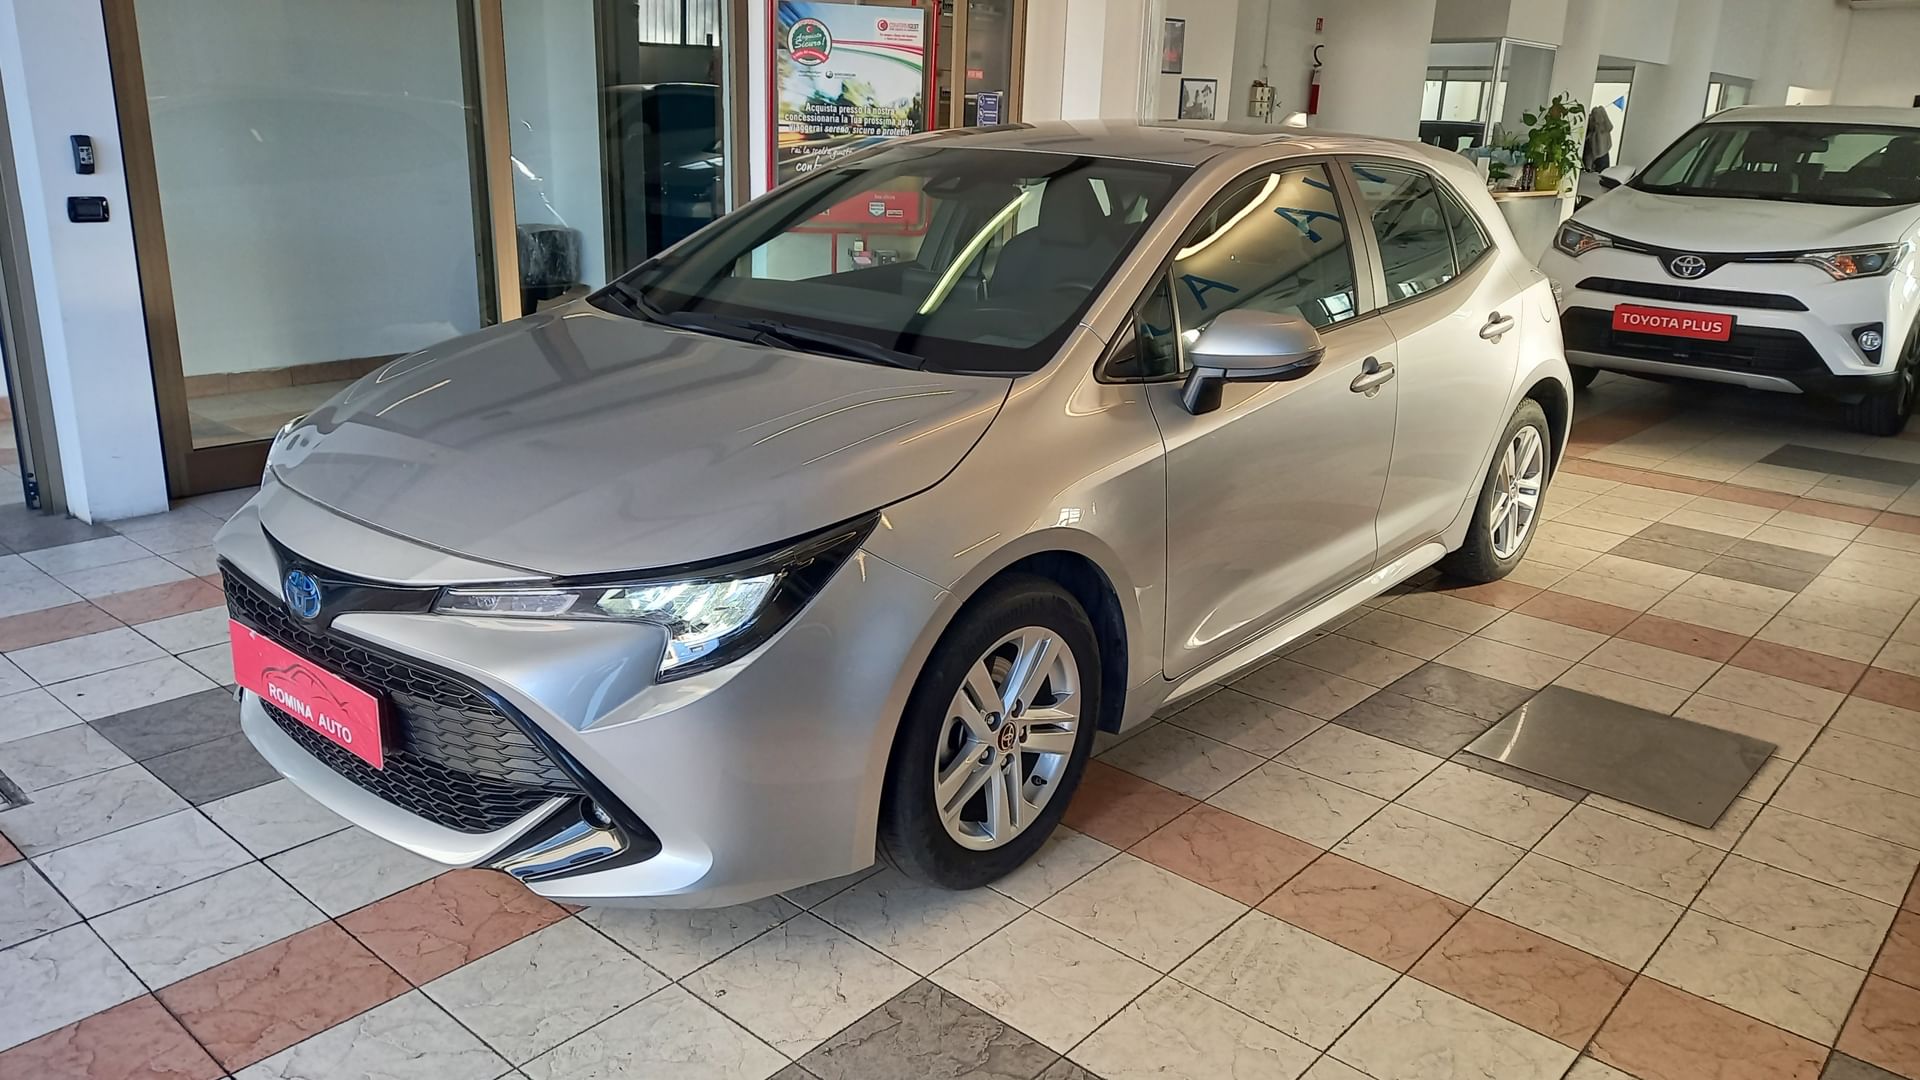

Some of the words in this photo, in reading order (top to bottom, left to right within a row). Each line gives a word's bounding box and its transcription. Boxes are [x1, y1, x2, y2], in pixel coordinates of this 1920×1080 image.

[805, 102, 838, 114] Acquista
[838, 105, 862, 116] presso
[864, 105, 871, 114] la
[872, 106, 895, 115] nostra
[784, 112, 840, 123] concessionaria
[841, 114, 848, 123] la
[850, 115, 862, 124] Tua
[863, 116, 896, 127] prossima
[898, 117, 915, 127] auto,
[789, 122, 823, 133] viaggerai
[824, 125, 851, 135] sereno,
[852, 126, 875, 135] sicuro
[881, 126, 913, 137] protetto!
[1621, 312, 1679, 329] TOYOTA
[1682, 319, 1723, 333] PLUS
[267, 682, 314, 722] ROMINA
[318, 712, 353, 744] AUTO
